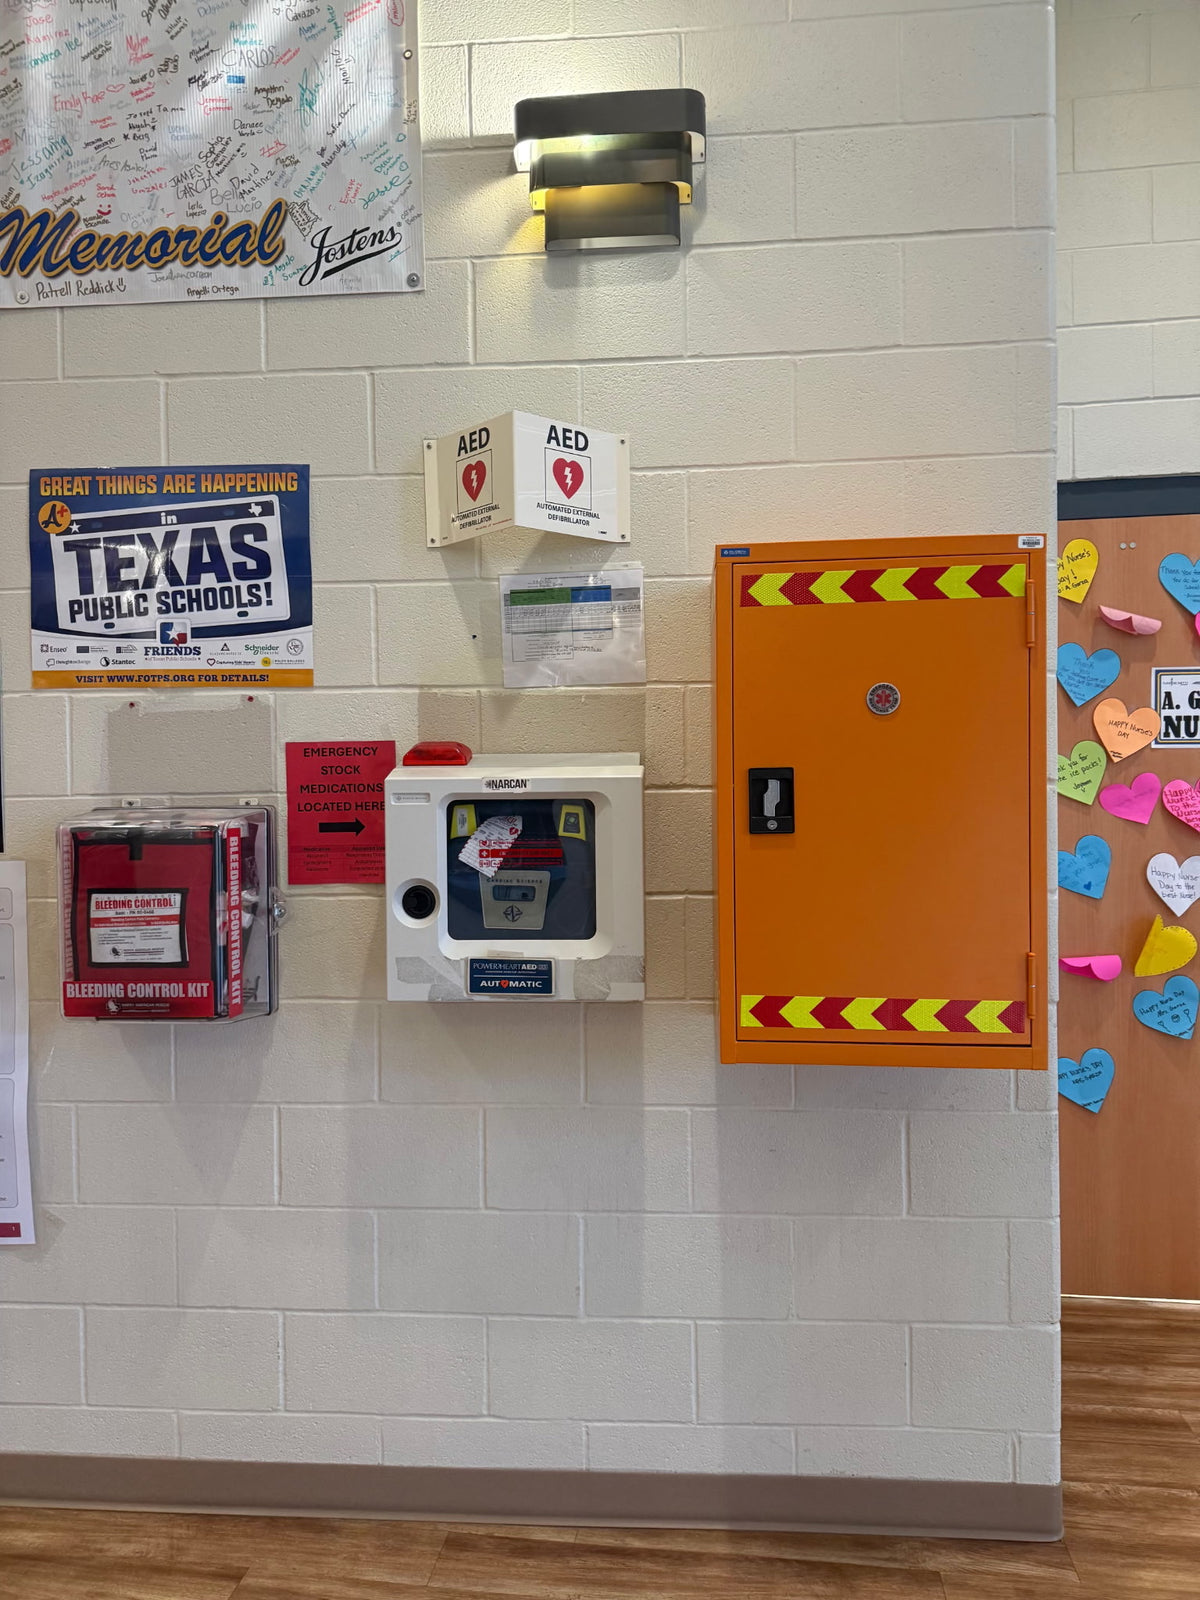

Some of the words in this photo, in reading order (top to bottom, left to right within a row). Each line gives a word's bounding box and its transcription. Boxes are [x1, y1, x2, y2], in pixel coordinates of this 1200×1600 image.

[222, 46, 276, 68] CARLOS
[198, 136, 225, 163] Sophia
[169, 164, 204, 188] JAMES
[176, 170, 218, 200] GARCIA
[230, 163, 259, 190] David
[239, 170, 276, 201] Martinez
[0, 198, 286, 278] Memorial
[299, 226, 402, 286] Jostens
[36, 281, 72, 302] Patrell
[76, 279, 114, 296] Reddick
[212, 286, 240, 296] Ortega
[457, 426, 490, 456] AED
[546, 424, 590, 452] AED
[40, 476, 92, 496] GREAT
[96, 475, 157, 494] THINGS
[162, 474, 196, 493] ARE
[200, 472, 298, 492] HAPPENING
[160, 512, 178, 525] in
[451, 510, 478, 523] AUTOMATED
[478, 504, 500, 516] EXTERNAL
[536, 502, 572, 516] AUTOMATED
[572, 508, 600, 520] EXTERNAL
[548, 514, 590, 526] DEFIBRILLATOR
[460, 515, 492, 530] DEFIBRILLATOR
[63, 522, 272, 596] TEXAS
[68, 592, 149, 624] PUBLIC
[156, 582, 273, 614] SCHOOLS!
[144, 646, 201, 656] FRIENDS
[107, 674, 195, 682] WWW.FOTPS.ORG
[198, 674, 218, 682] FOR
[221, 674, 270, 682] DETAILS!
[1162, 691, 1181, 710] A.
[1108, 720, 1129, 730] HAPPY
[303, 747, 378, 758] EMERGENCY
[320, 765, 361, 776] STOCK
[300, 784, 384, 794] MEDICATIONS
[491, 779, 528, 790] NARCAN
[298, 802, 352, 812] LOCATED
[355, 801, 385, 812] HERE
[229, 836, 240, 907] BLEEDING
[1150, 866, 1176, 880] Happy
[1158, 880, 1174, 892] Day
[95, 900, 132, 910] BLEEDING
[134, 898, 174, 908] CONTROL
[230, 910, 241, 978] CONTROL
[66, 983, 124, 998] BLEEDING
[127, 983, 186, 998] CONTROL
[188, 982, 210, 998] KIT
[232, 980, 242, 1004] KIT
